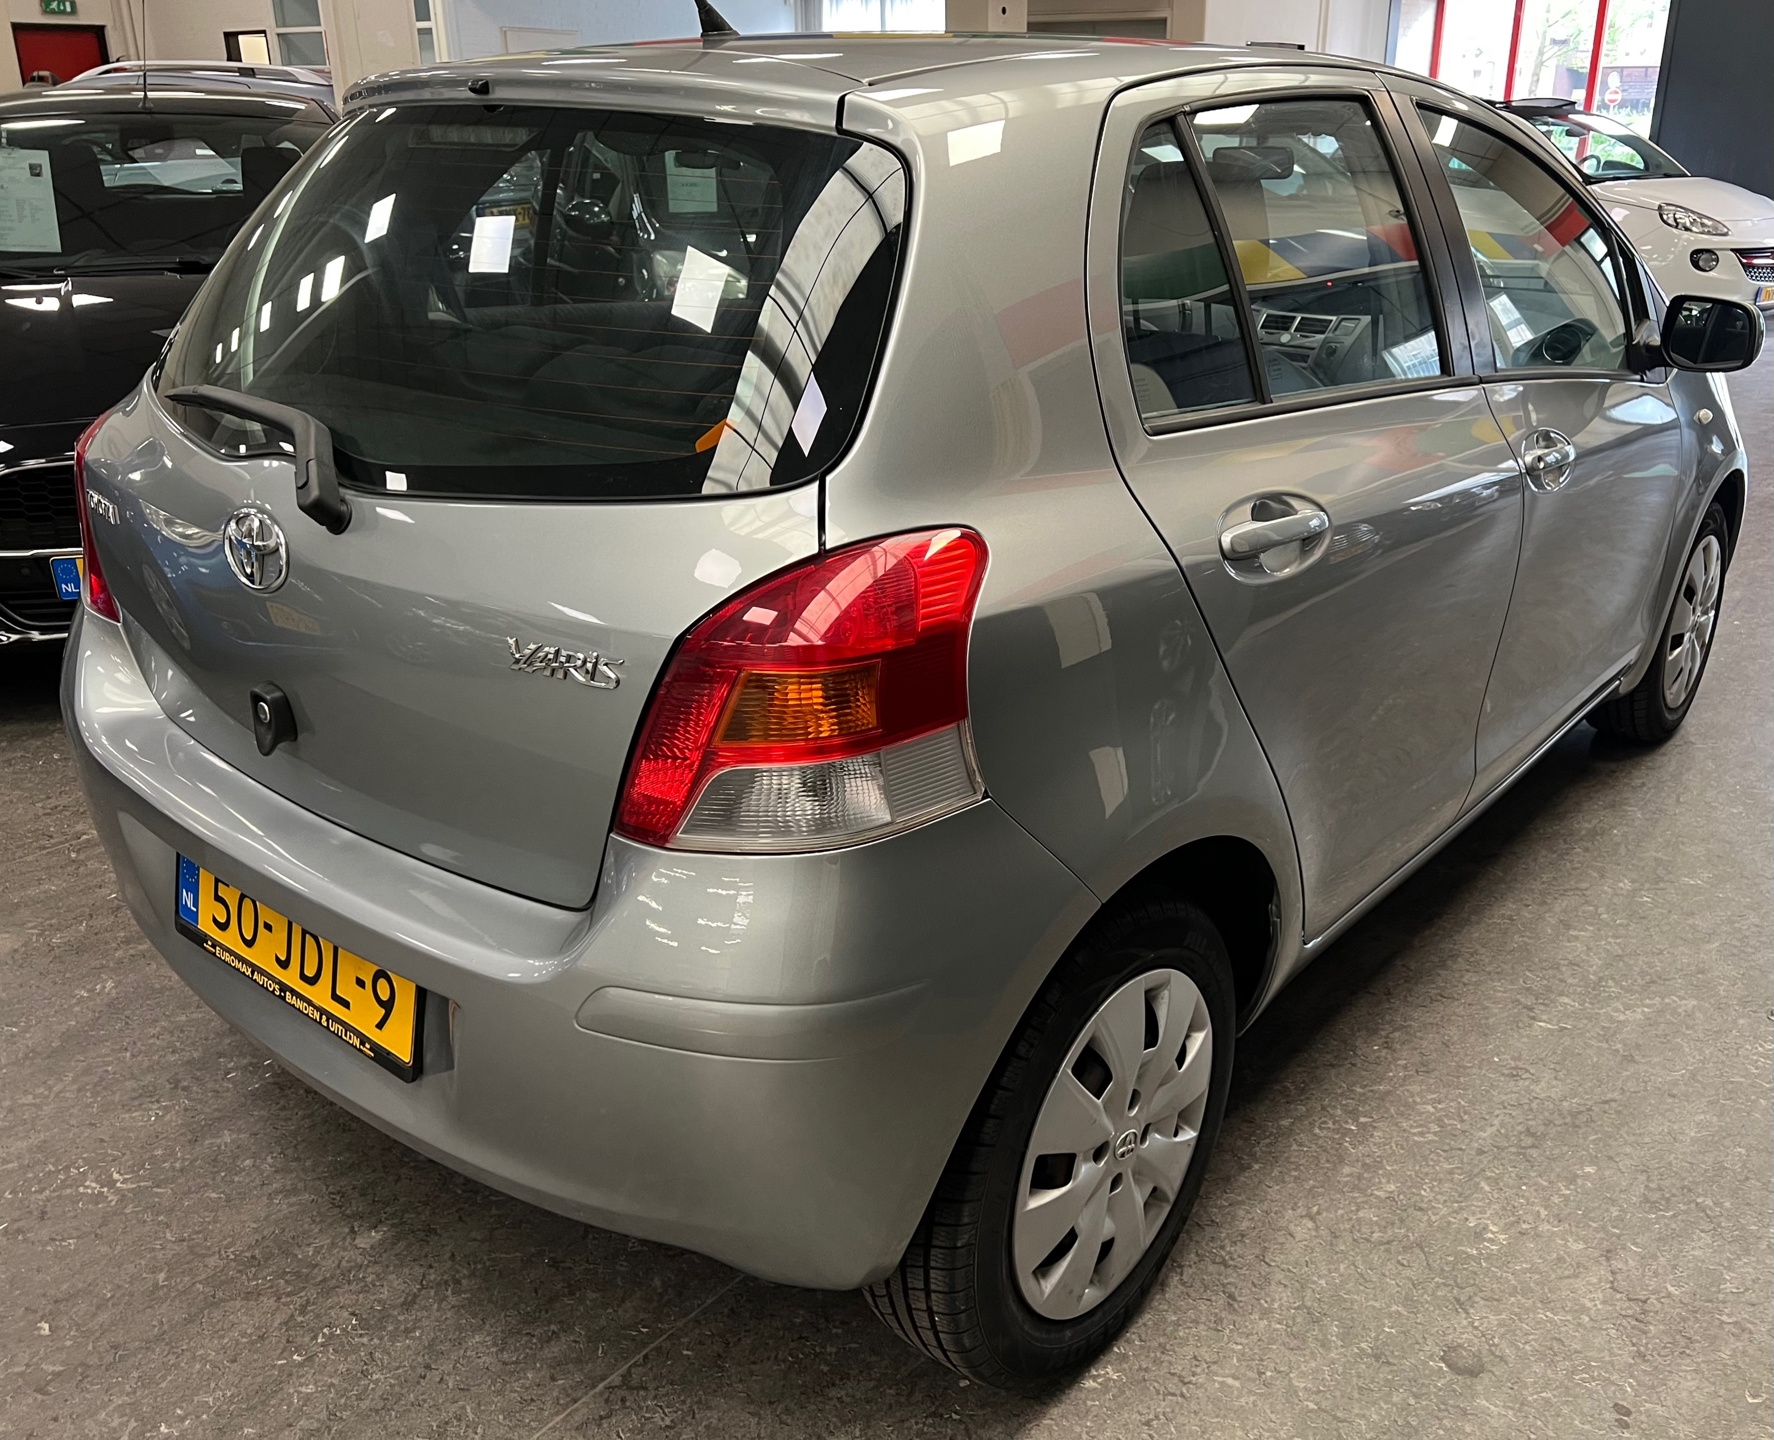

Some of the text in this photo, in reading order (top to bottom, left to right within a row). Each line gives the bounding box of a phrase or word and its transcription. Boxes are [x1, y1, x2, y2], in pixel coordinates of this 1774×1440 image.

[61, 583, 80, 593] NL
[182, 888, 197, 912] NL
[212, 876, 396, 1032] 50-JDL-9
[215, 946, 252, 978] EUROMAX
[253, 970, 280, 996] AUTO'S
[285, 991, 320, 1022] BANDEN
[321, 1014, 328, 1027] &
[328, 1019, 360, 1049] UITLIJN
